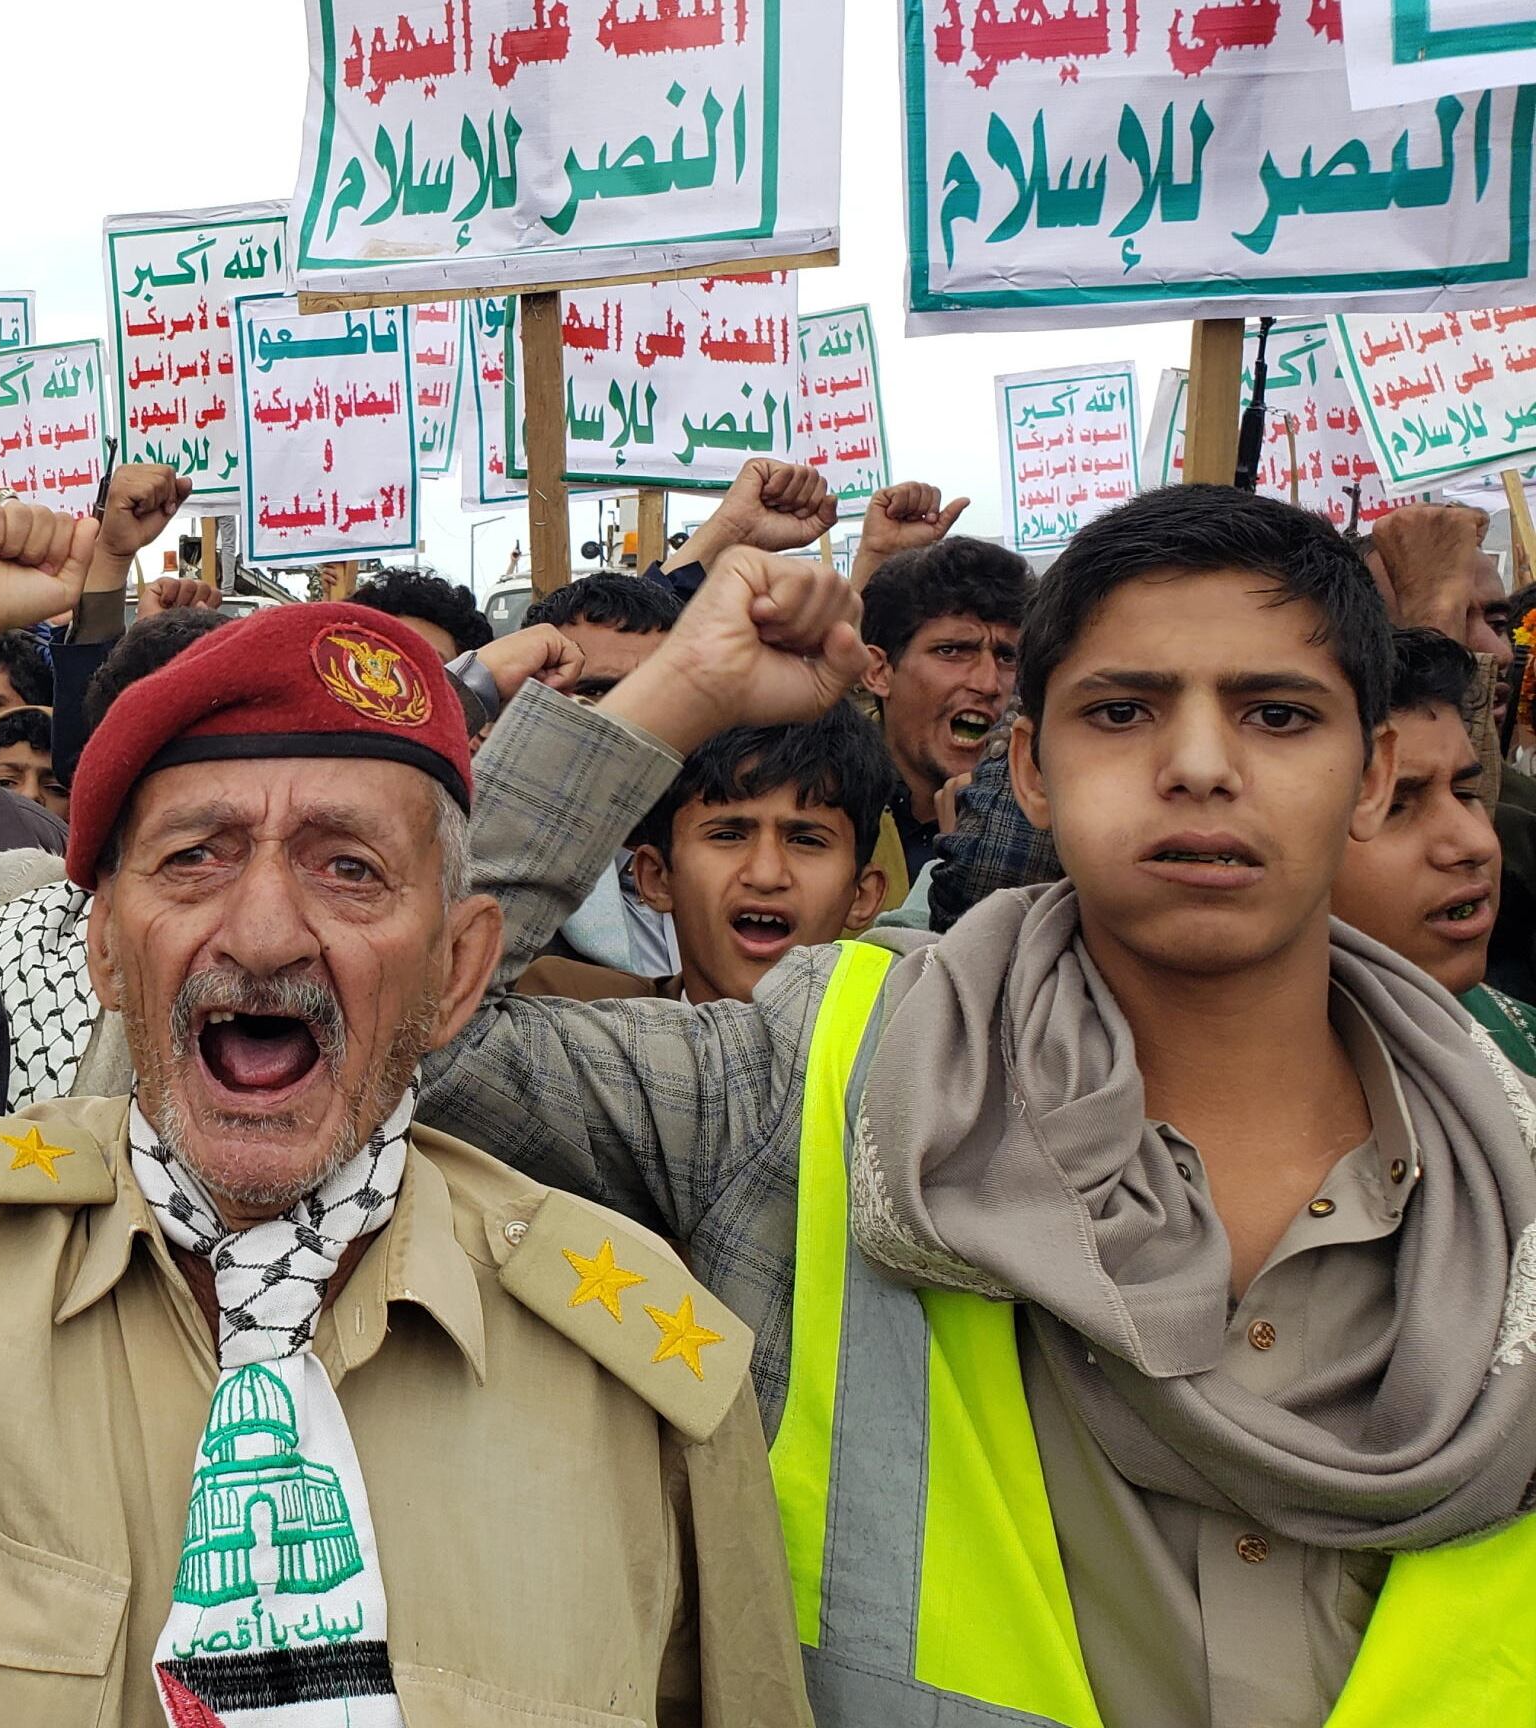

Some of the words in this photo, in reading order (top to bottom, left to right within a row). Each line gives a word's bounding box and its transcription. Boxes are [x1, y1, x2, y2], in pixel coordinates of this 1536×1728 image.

[343, 0, 473, 107] اليهود
[326, 105, 523, 253] للإسلام
[540, 80, 747, 237] النصر
[940, 99, 1214, 275] للإسلام
[122, 233, 217, 302] أكبر
[223, 234, 282, 279] الله
[126, 295, 208, 342] لأمريكا
[634, 303, 686, 369] على
[699, 310, 790, 365] اللعنة
[818, 321, 865, 357] الله
[247, 308, 398, 373] قاطعوا
[42, 356, 95, 400] الله
[128, 348, 211, 390] لإسرائيل
[814, 366, 869, 398] الموت
[1372, 362, 1446, 411] اليهود
[1454, 352, 1495, 395] على
[129, 395, 187, 434] اليهود
[195, 393, 227, 430] على
[253, 376, 331, 434] الأمريكية
[335, 380, 401, 429] البضائع
[819, 401, 874, 433] الموت
[1014, 384, 1080, 429] أكبر
[1085, 384, 1126, 412] الله
[39, 413, 96, 450] الموت
[673, 382, 793, 466] النصر
[1016, 422, 1074, 452] لأمريكا
[1080, 422, 1128, 446] الموت
[1391, 400, 1489, 468] للإسلام
[323, 438, 334, 473] و
[836, 436, 878, 462] اللعنة
[1081, 452, 1130, 476] الموت
[43, 457, 100, 494] الموت
[1066, 484, 1089, 508] على
[258, 484, 406, 538] الإسرائيلية
[1019, 485, 1061, 510] اليهود
[294, 1600, 364, 1642] لبيك
